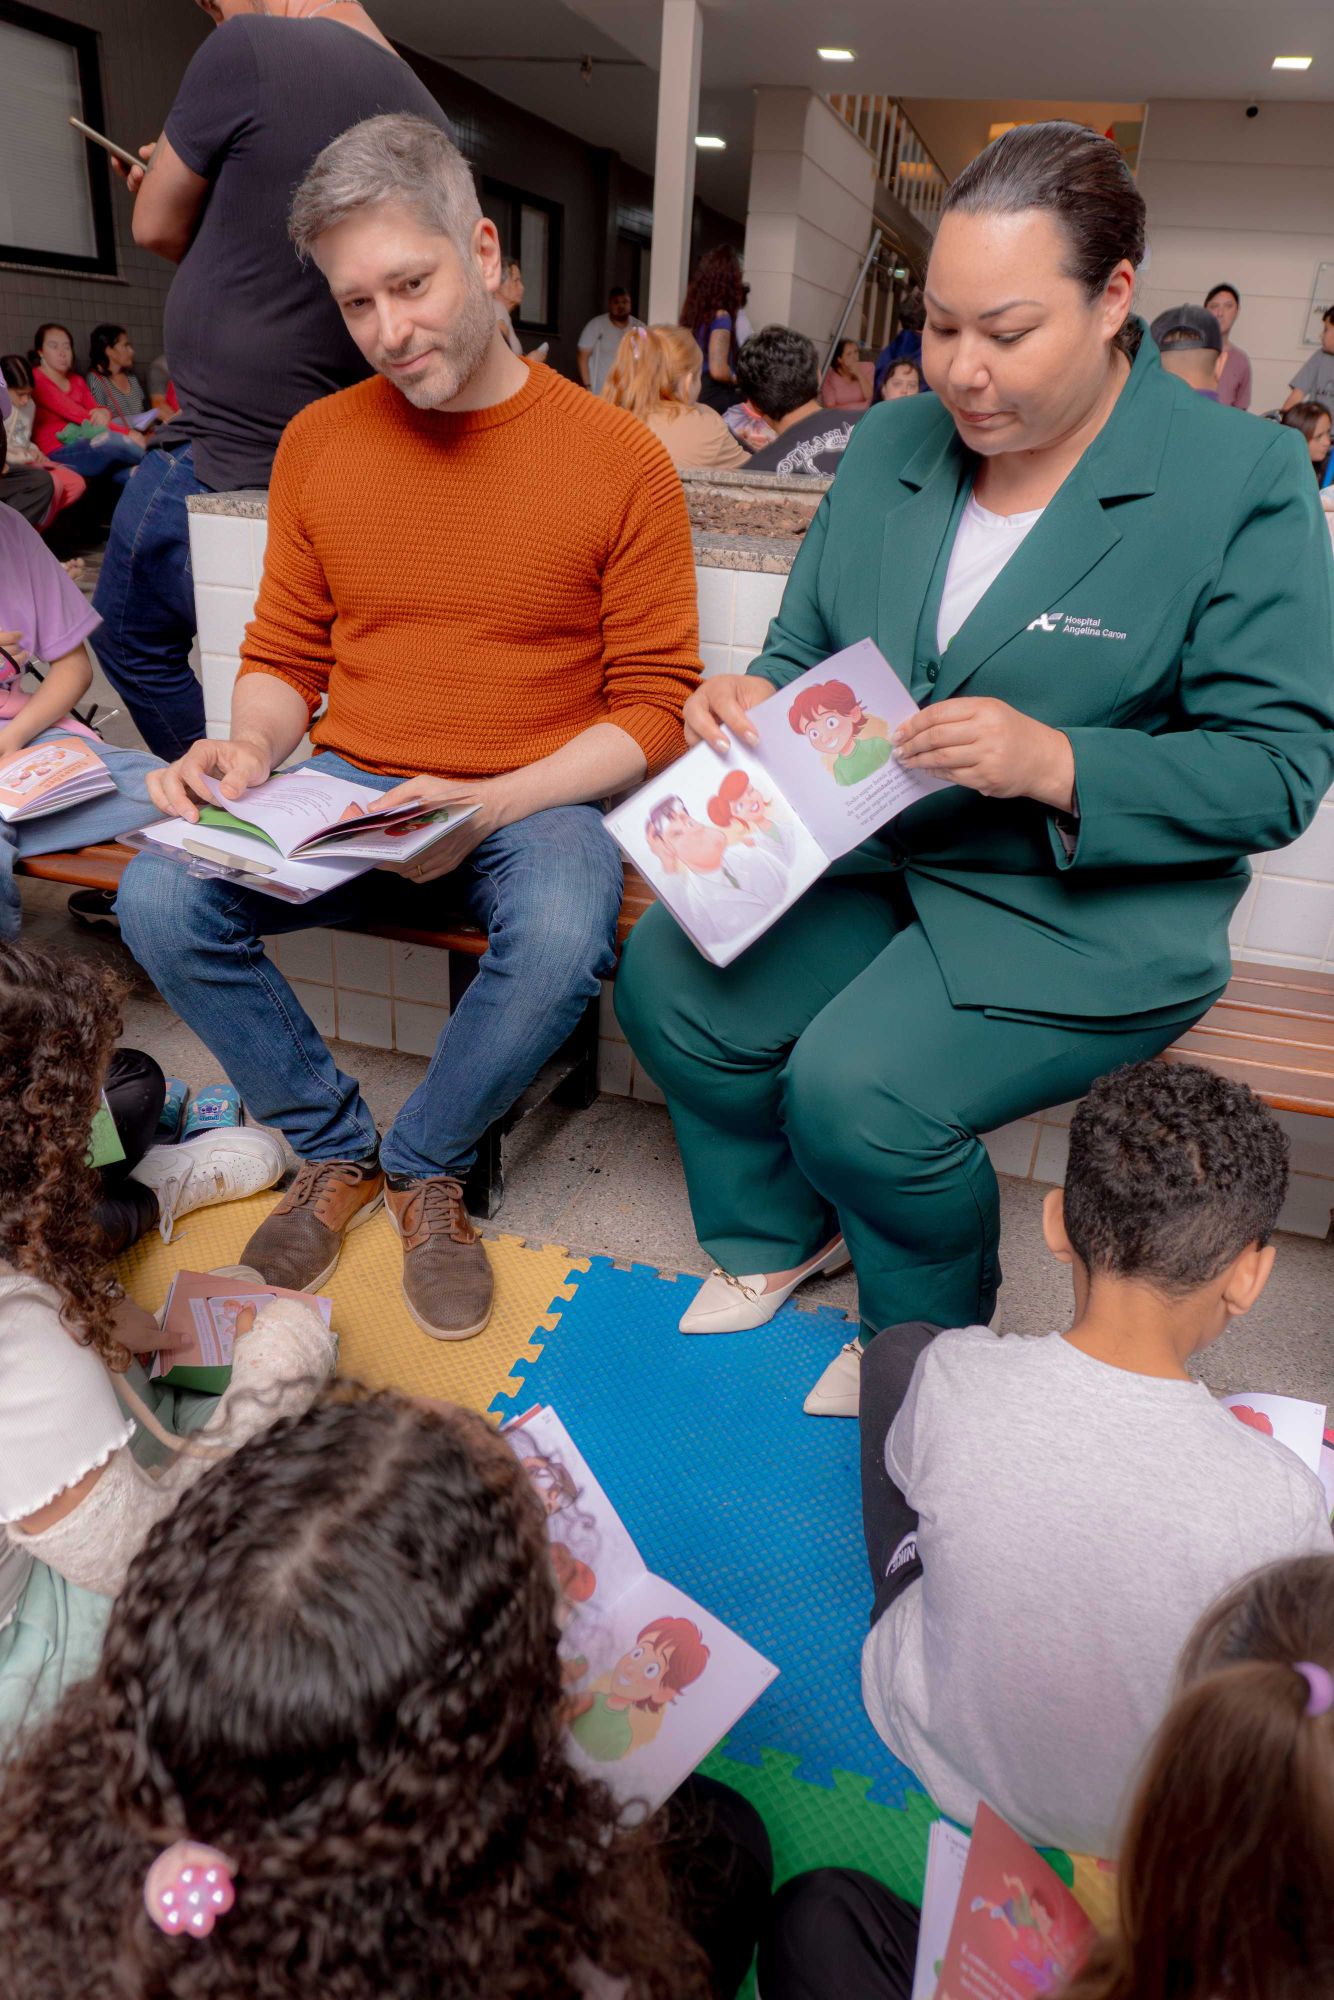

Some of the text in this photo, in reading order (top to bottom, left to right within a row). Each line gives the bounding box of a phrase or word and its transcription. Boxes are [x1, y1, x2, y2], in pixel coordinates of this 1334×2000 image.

[1065, 616, 1101, 627] Hospital
[1063, 625, 1126, 639] Angelina Caron
[890, 1543, 916, 1574] NIKE
